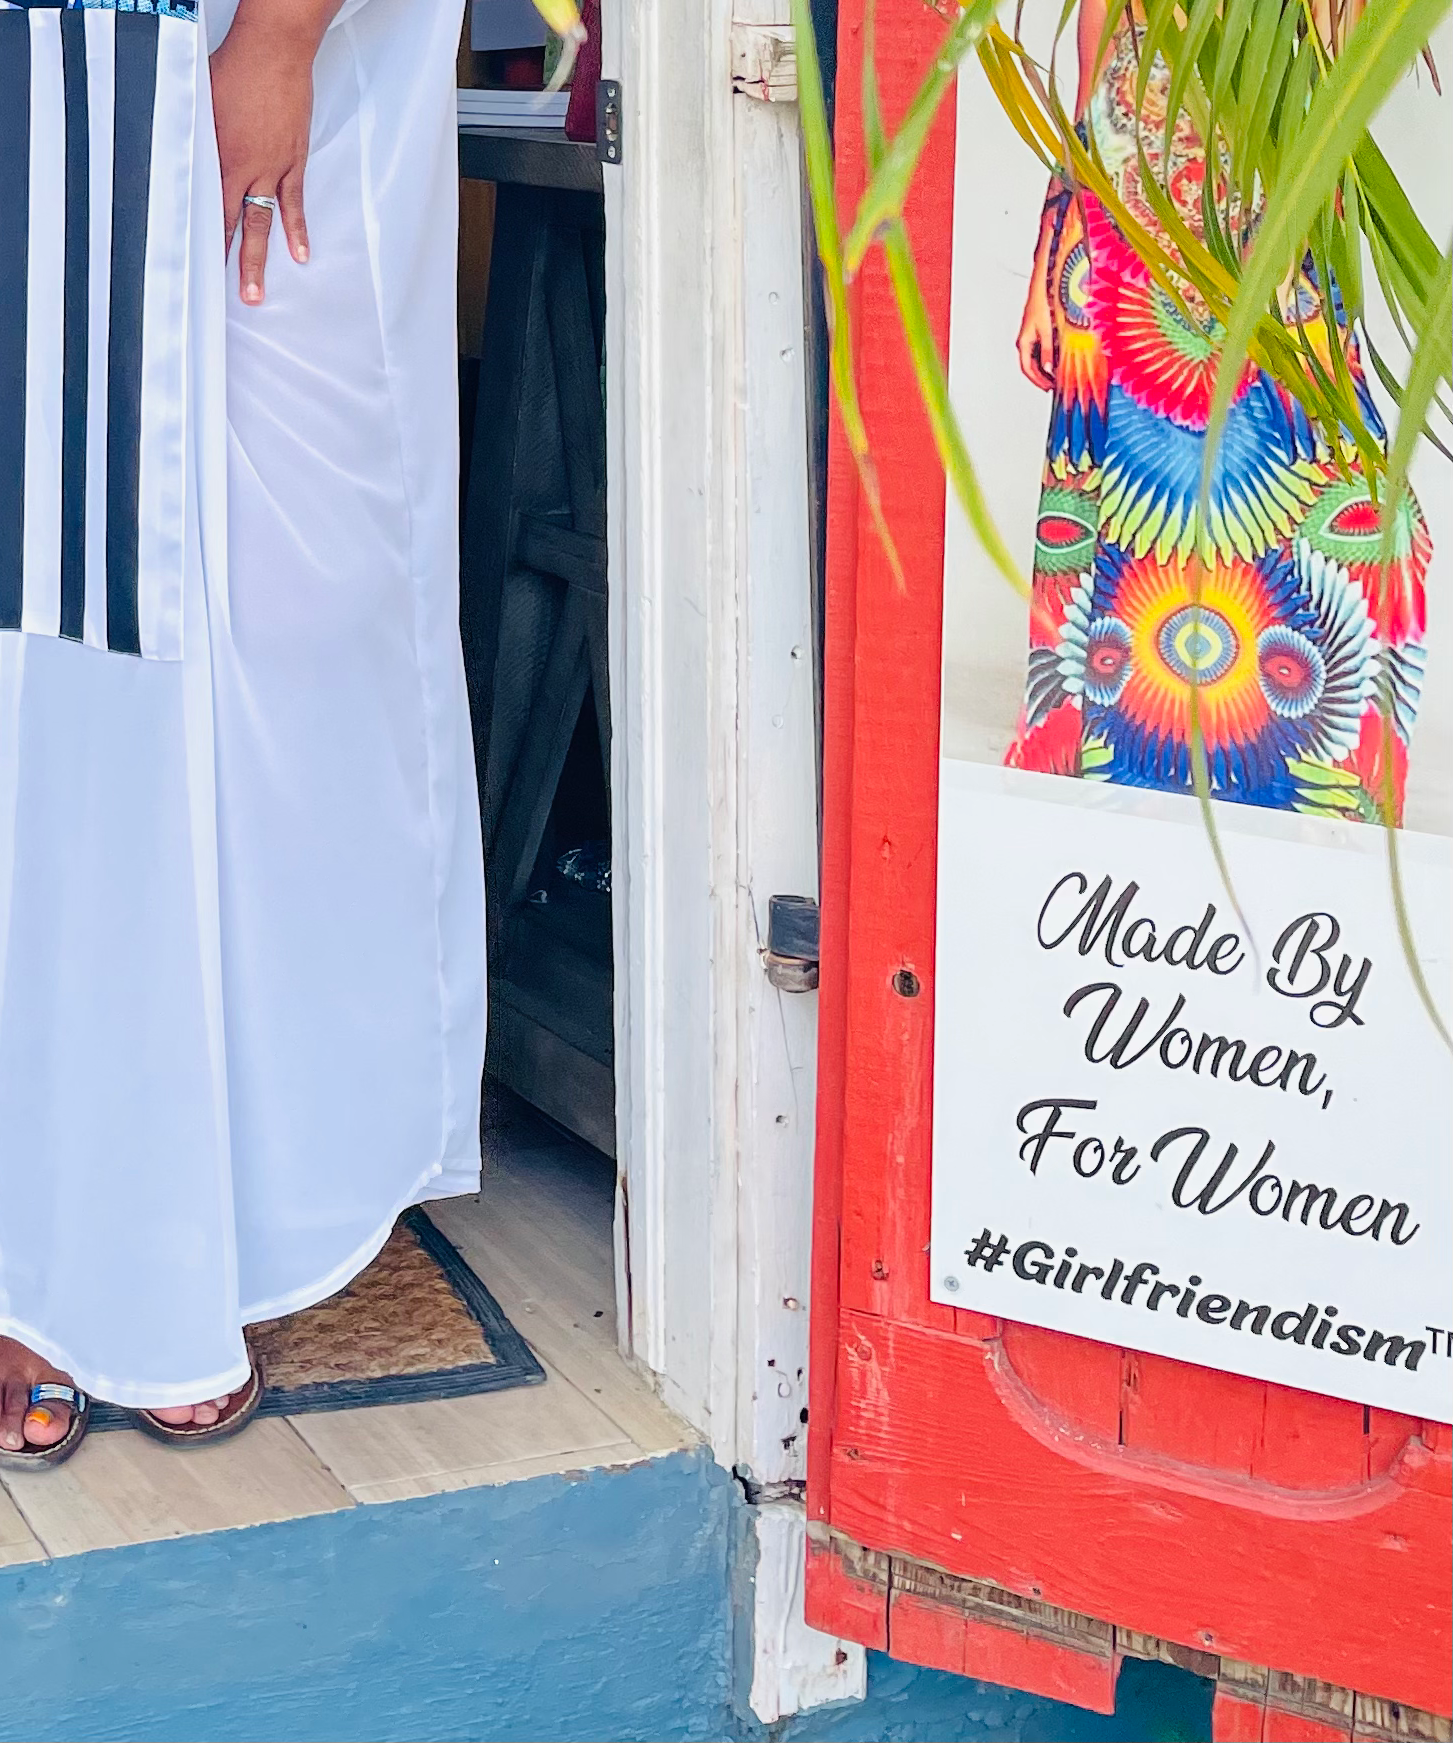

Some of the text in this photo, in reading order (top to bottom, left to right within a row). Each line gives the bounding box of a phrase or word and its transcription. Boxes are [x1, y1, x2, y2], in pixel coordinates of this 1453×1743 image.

[1037, 872, 1373, 1029] Made By
[1062, 982, 1334, 1110] Women,
[1016, 1098, 1421, 1246] For Women
